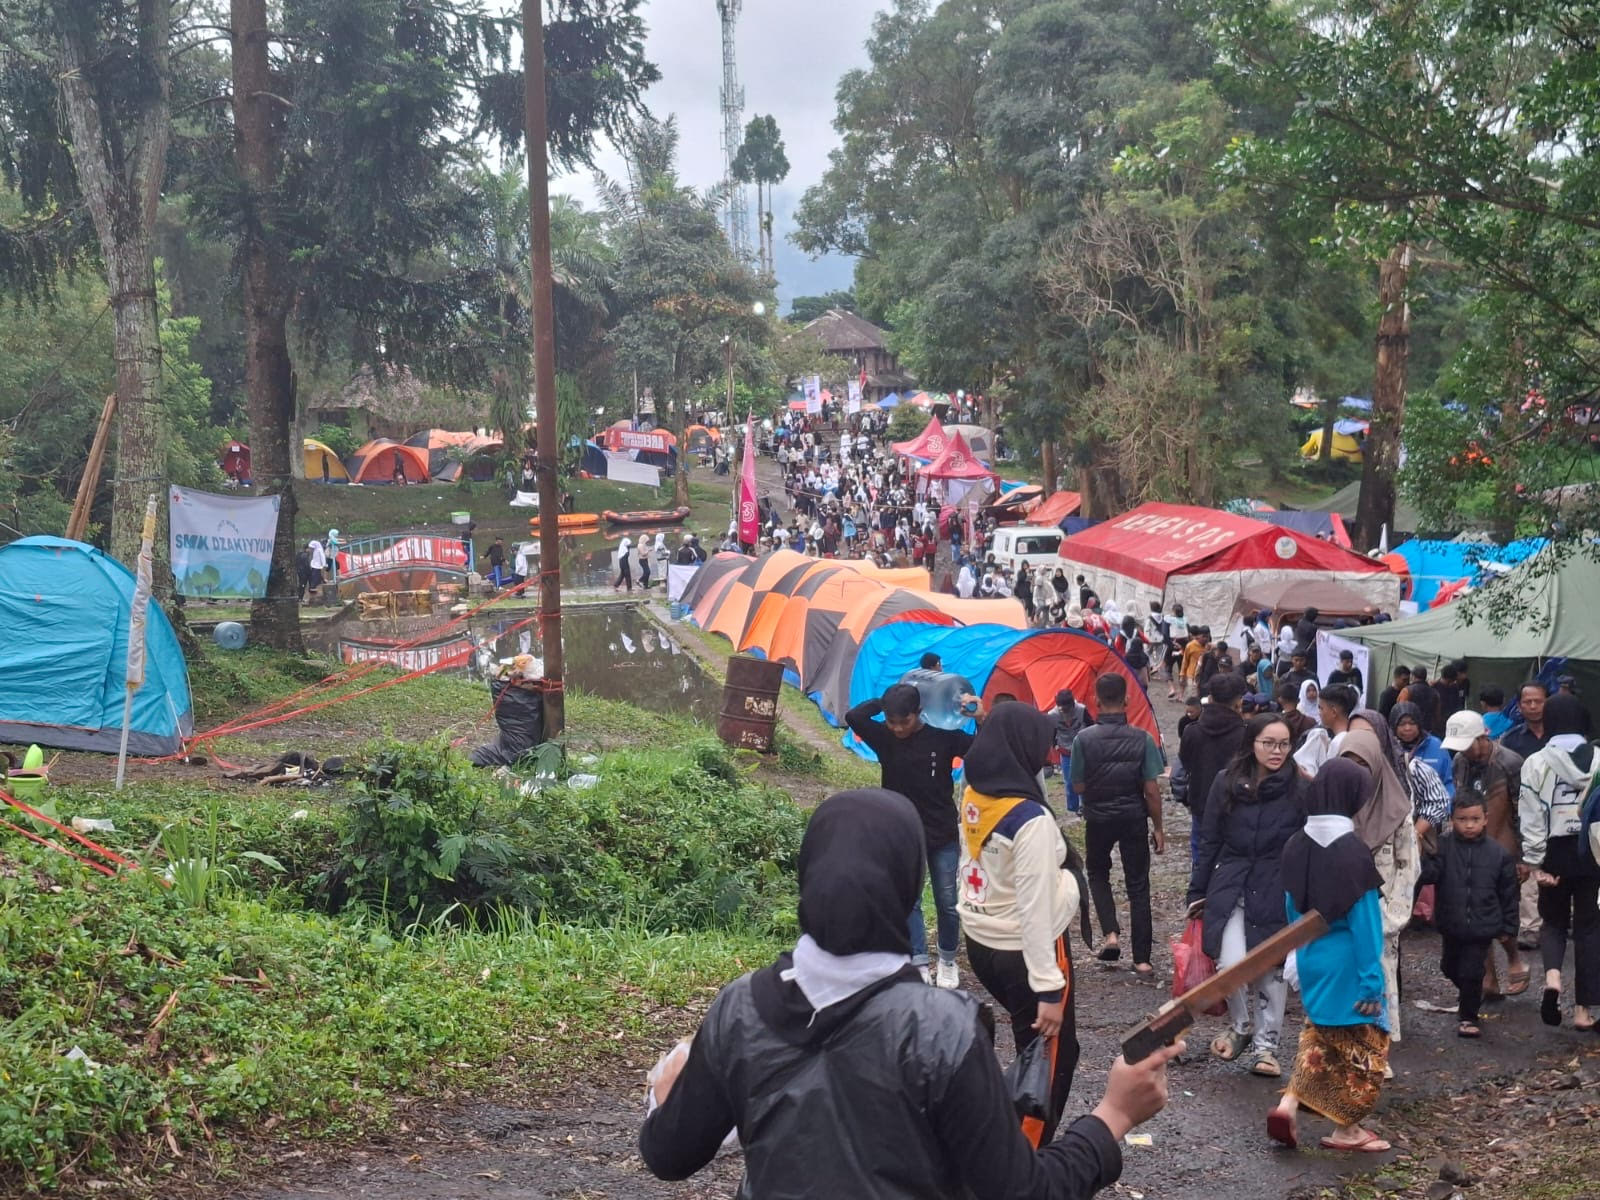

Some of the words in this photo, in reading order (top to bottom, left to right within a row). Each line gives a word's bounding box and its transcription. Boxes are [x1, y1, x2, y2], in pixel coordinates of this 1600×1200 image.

[927, 434, 944, 453] 3
[949, 451, 968, 471] 3
[742, 502, 755, 522] 3
[175, 534, 209, 551] SMK
[212, 537, 273, 553] DZAKIYYUN
